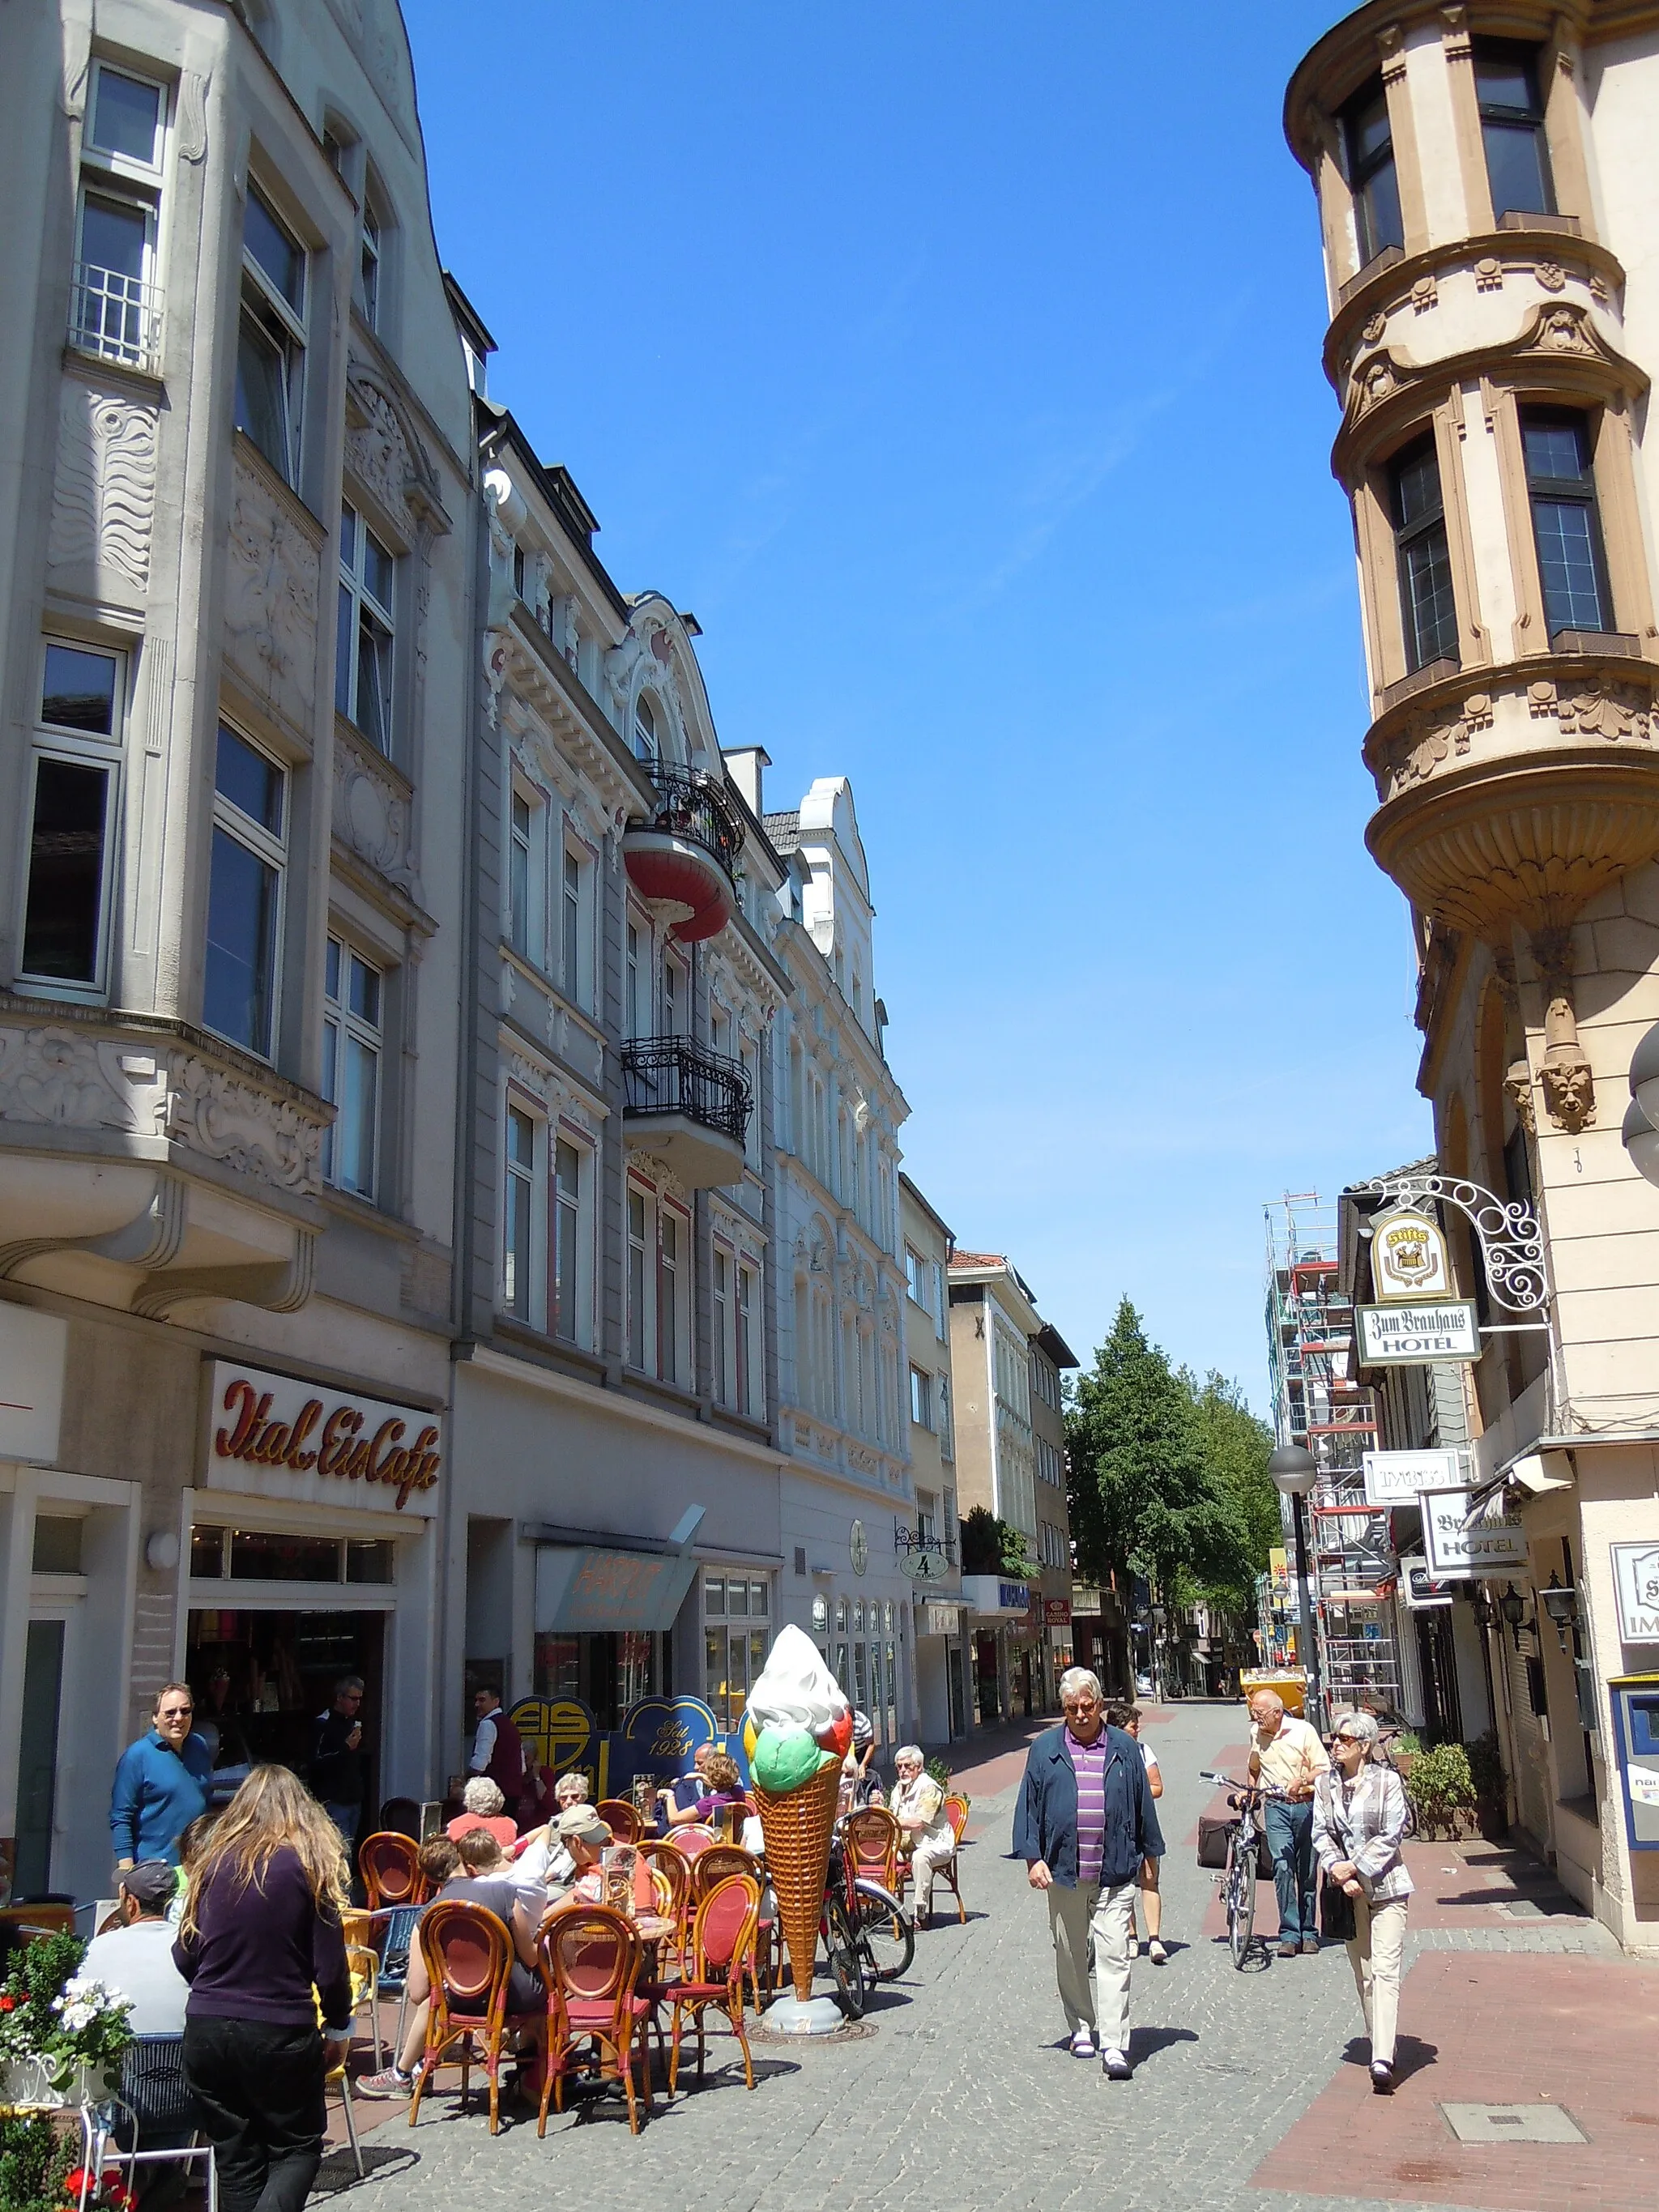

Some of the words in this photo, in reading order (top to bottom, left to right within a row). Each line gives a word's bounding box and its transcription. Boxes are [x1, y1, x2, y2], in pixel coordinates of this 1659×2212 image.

[1386, 1227, 1429, 1248] Stifts
[1371, 1312, 1401, 1340] Zum
[1401, 1309, 1465, 1336] Brauhaus
[1383, 1336, 1457, 1353] HOTEL
[1443, 1538, 1519, 1556] HOTEL
[917, 1554, 930, 1575] 4
[657, 1720, 690, 1738] Seit
[649, 1738, 694, 1757] 1928
